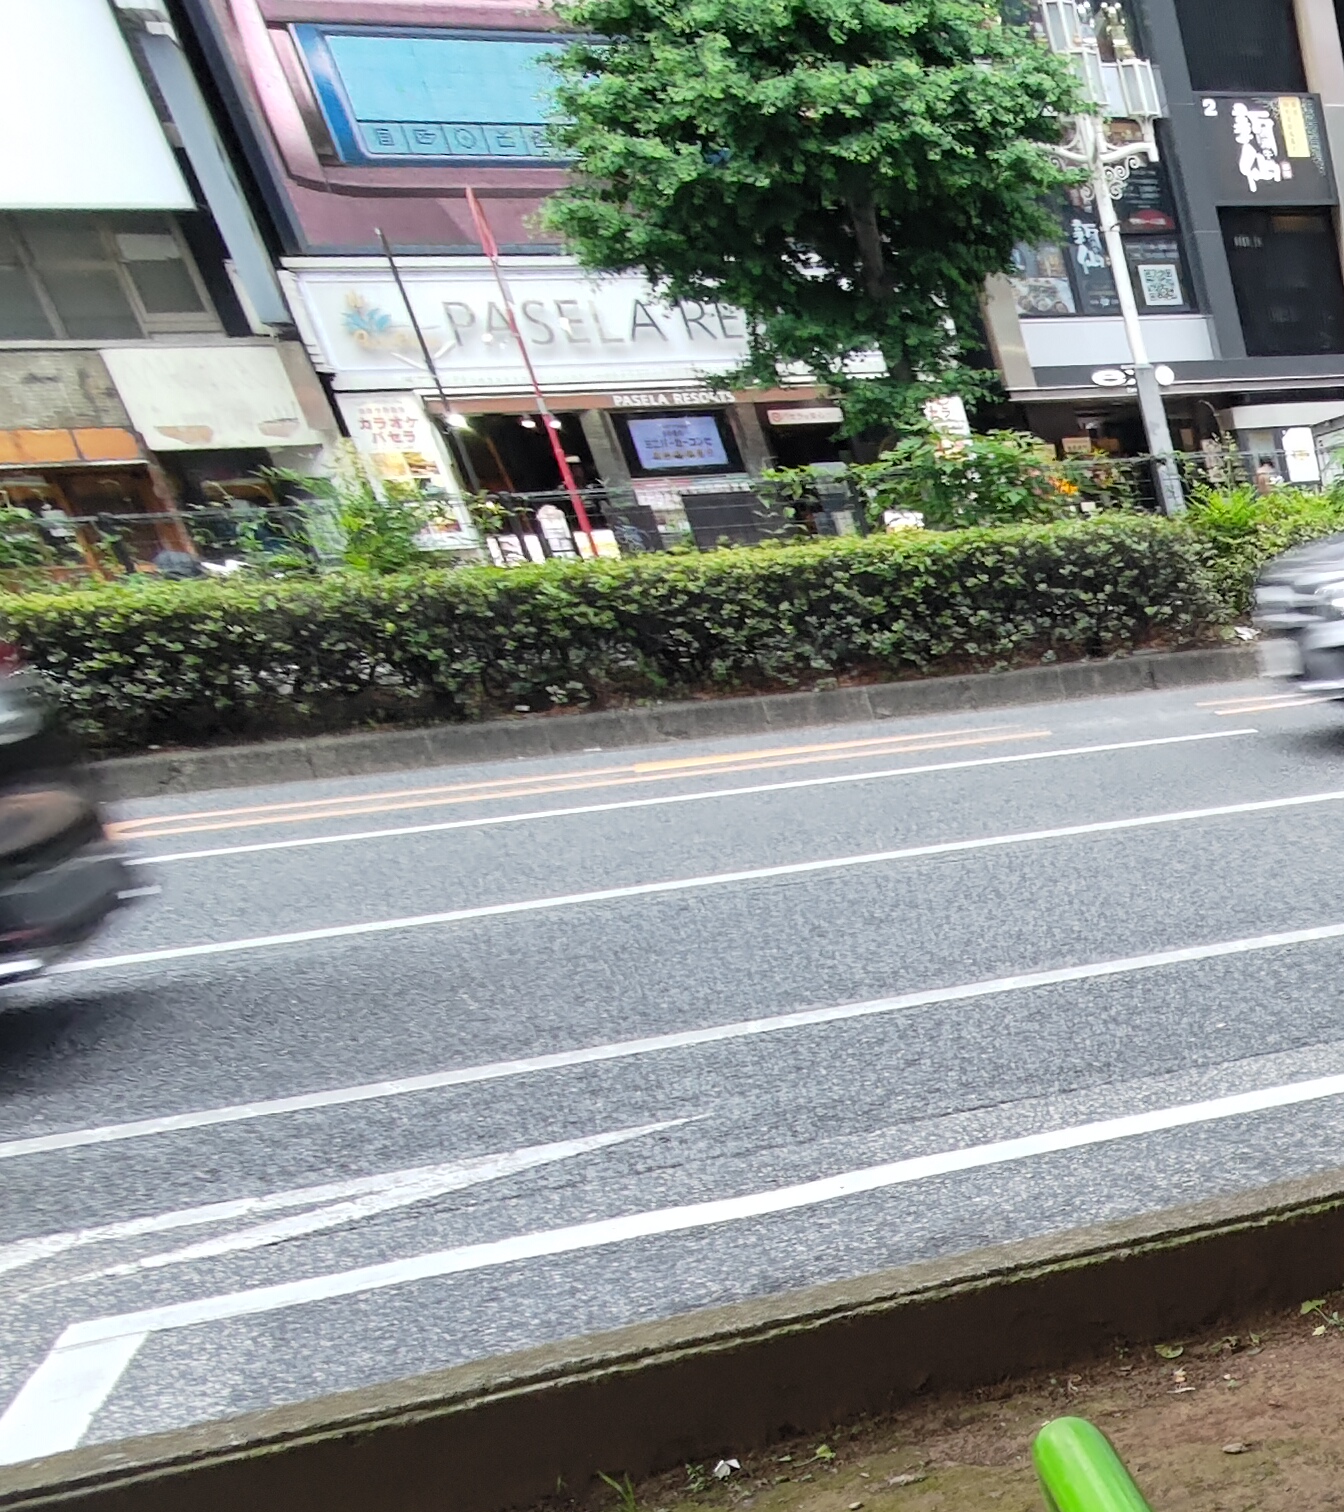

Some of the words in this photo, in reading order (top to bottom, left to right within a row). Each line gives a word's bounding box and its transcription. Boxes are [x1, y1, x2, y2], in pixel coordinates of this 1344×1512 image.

[1202, 98, 1218, 116] 2
[442, 299, 669, 346] PASELA
[612, 394, 670, 407] PASELA
[672, 390, 736, 405] RESORTS
[359, 416, 418, 430] カラオケ
[372, 431, 416, 443] パセラ
